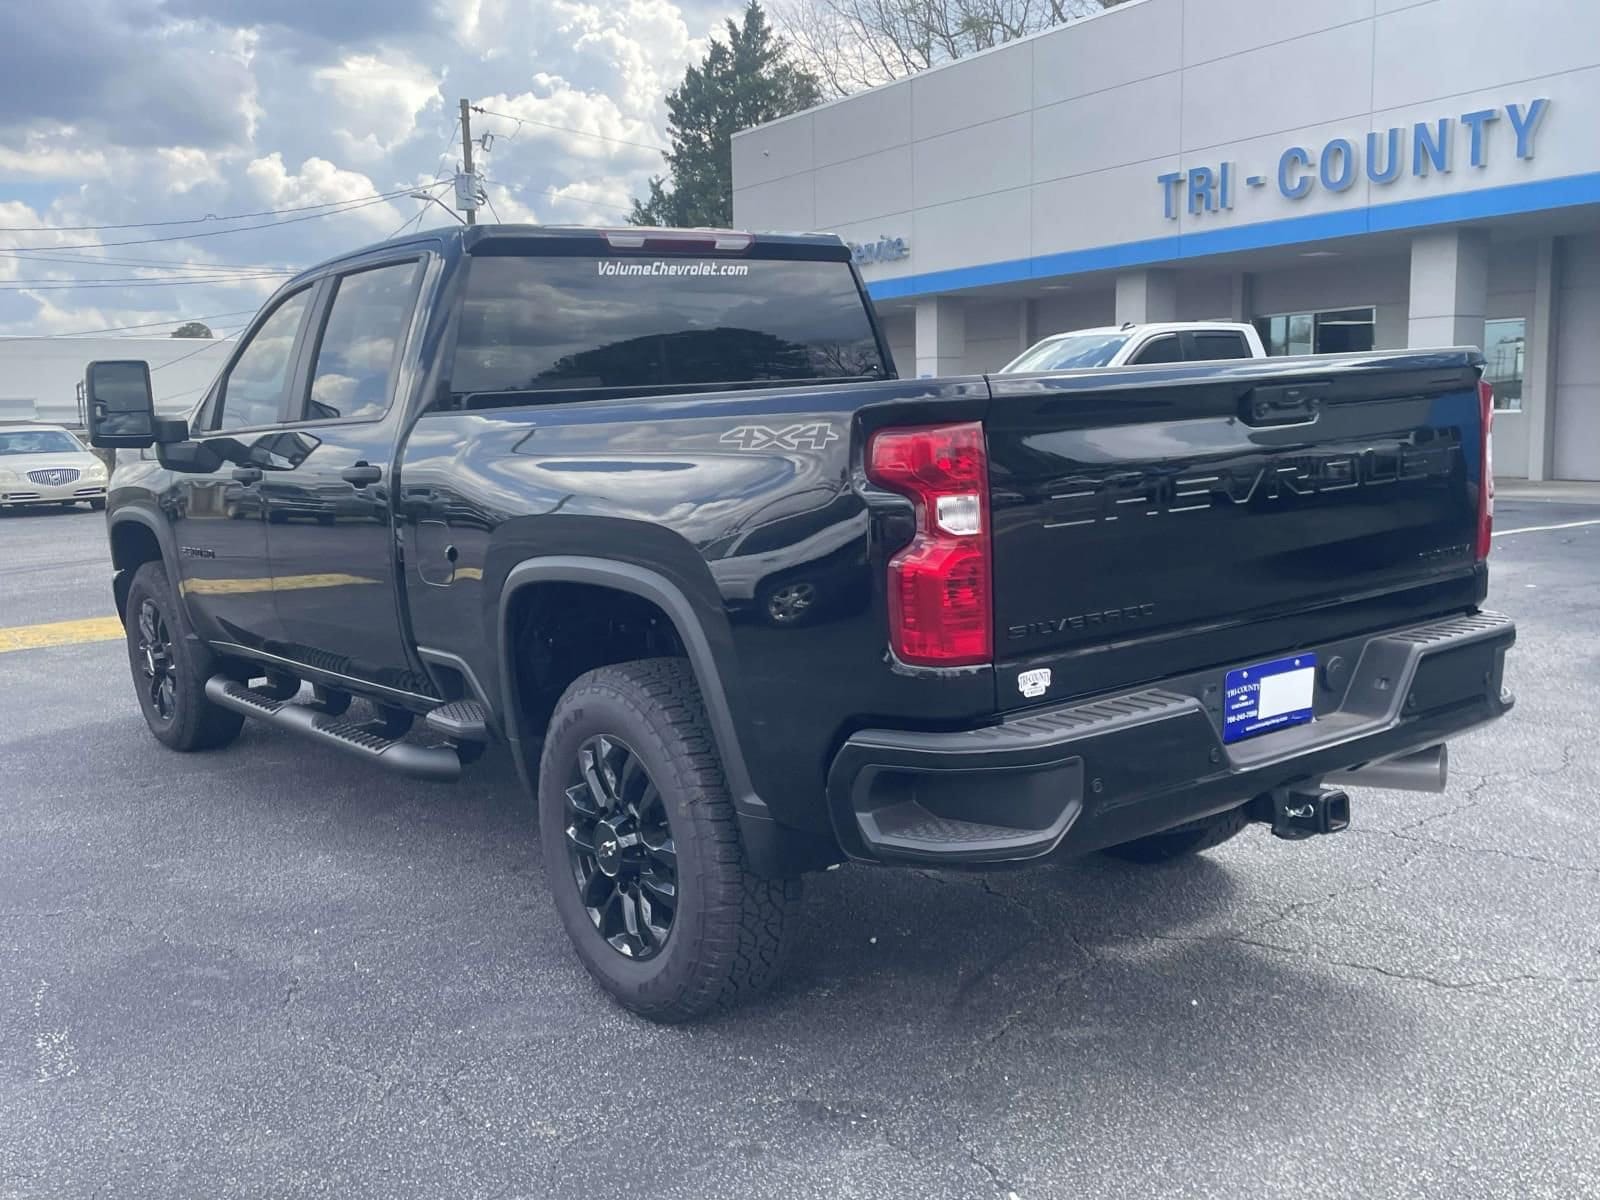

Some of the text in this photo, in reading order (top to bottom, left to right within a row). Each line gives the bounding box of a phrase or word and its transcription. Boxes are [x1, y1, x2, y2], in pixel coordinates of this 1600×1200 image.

[1277, 98, 1550, 200] COUNTY
[847, 234, 910, 265] ervice
[598, 261, 749, 276] VolumeChevrolet.com
[1008, 602, 1155, 639] SILVERADO
